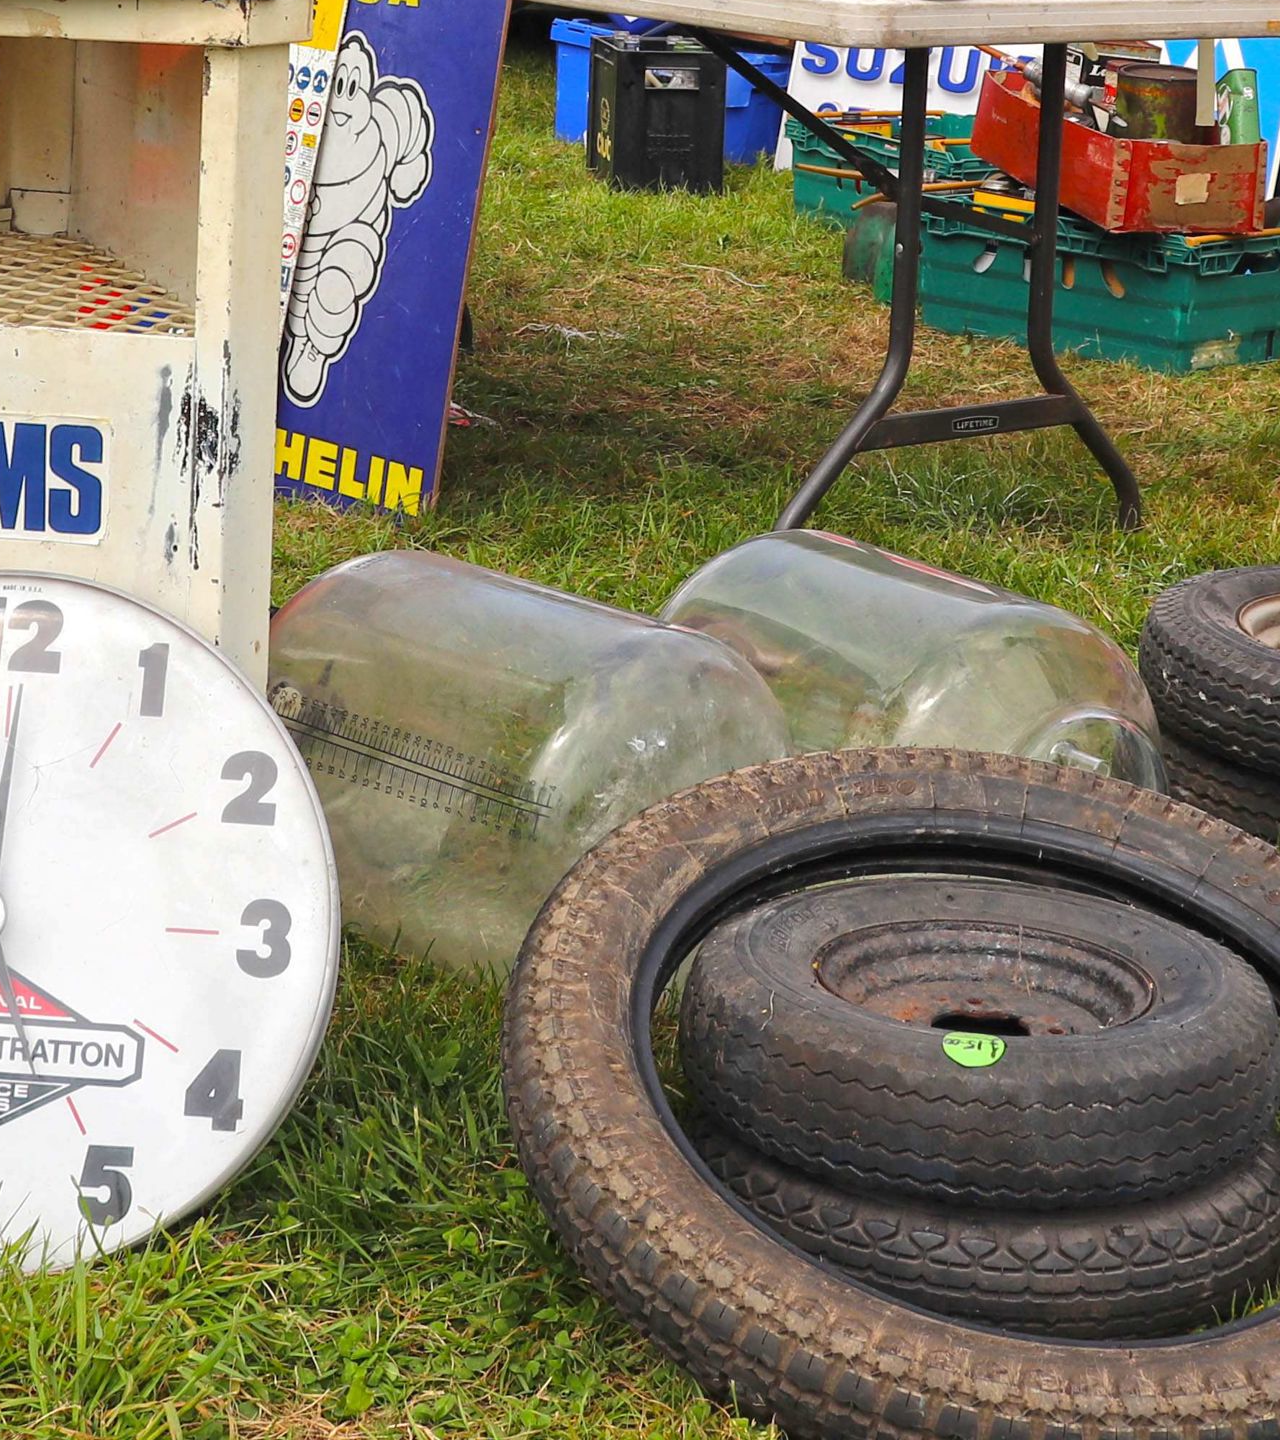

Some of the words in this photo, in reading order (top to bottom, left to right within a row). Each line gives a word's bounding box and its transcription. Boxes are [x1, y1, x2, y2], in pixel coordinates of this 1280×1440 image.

[274, 428, 424, 518] HELIN
[138, 642, 170, 717] 1
[220, 750, 278, 826] 2
[235, 898, 292, 979] 3
[183, 1049, 243, 1132] 4
[78, 1144, 134, 1227] 5
